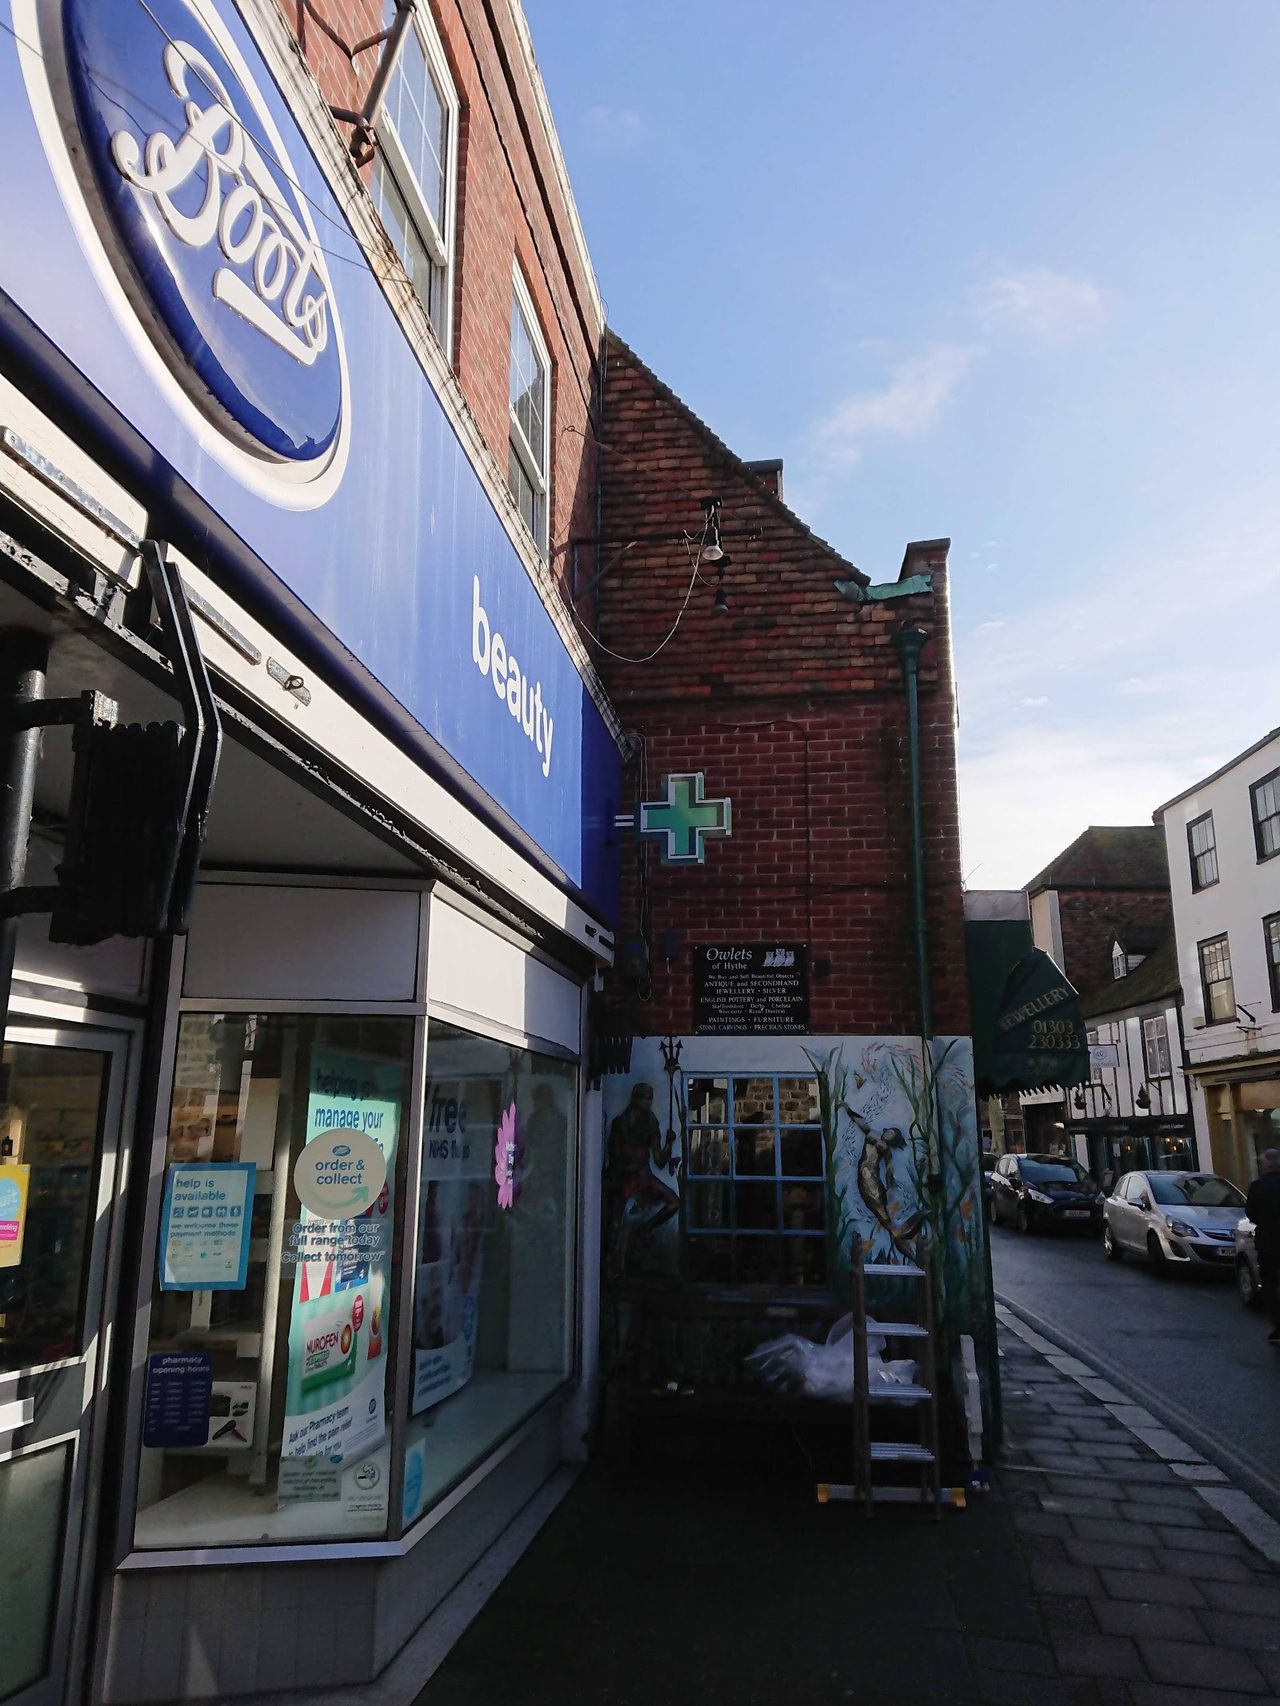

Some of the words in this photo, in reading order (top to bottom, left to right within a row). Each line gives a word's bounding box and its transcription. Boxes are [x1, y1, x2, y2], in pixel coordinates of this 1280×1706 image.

[110, 39, 329, 364] Boots
[472, 574, 555, 778] beauty
[706, 947, 753, 960] Owlets
[724, 962, 747, 970] Hythe
[1000, 987, 1069, 1031] JEWELLERY
[1033, 1019, 1074, 1034] 01303
[1028, 1034, 1080, 1049] 230333
[314, 1107, 360, 1129] manage
[362, 1110, 384, 1132] your
[428, 1140, 449, 1160] NHS
[315, 1159, 353, 1171] order
[356, 1159, 365, 1171] &
[175, 1179, 201, 1189] help
[205, 1179, 215, 1187] is
[316, 1173, 362, 1185] collect
[174, 1191, 226, 1201] available
[0, 1223, 19, 1232] moking
[293, 1222, 328, 1235] Order
[329, 1222, 356, 1234] from
[359, 1223, 381, 1234] our
[288, 1234, 309, 1247] full
[310, 1236, 345, 1248] range
[347, 1233, 381, 1247] today
[281, 1250, 323, 1263] Collect
[306, 1331, 339, 1355] NUROFEN
[161, 1356, 203, 1365] pharmacy
[152, 1366, 186, 1375] opening
[187, 1365, 211, 1373] hours
[289, 1431, 299, 1444] Ask
[308, 1412, 336, 1432] Pharmacy
